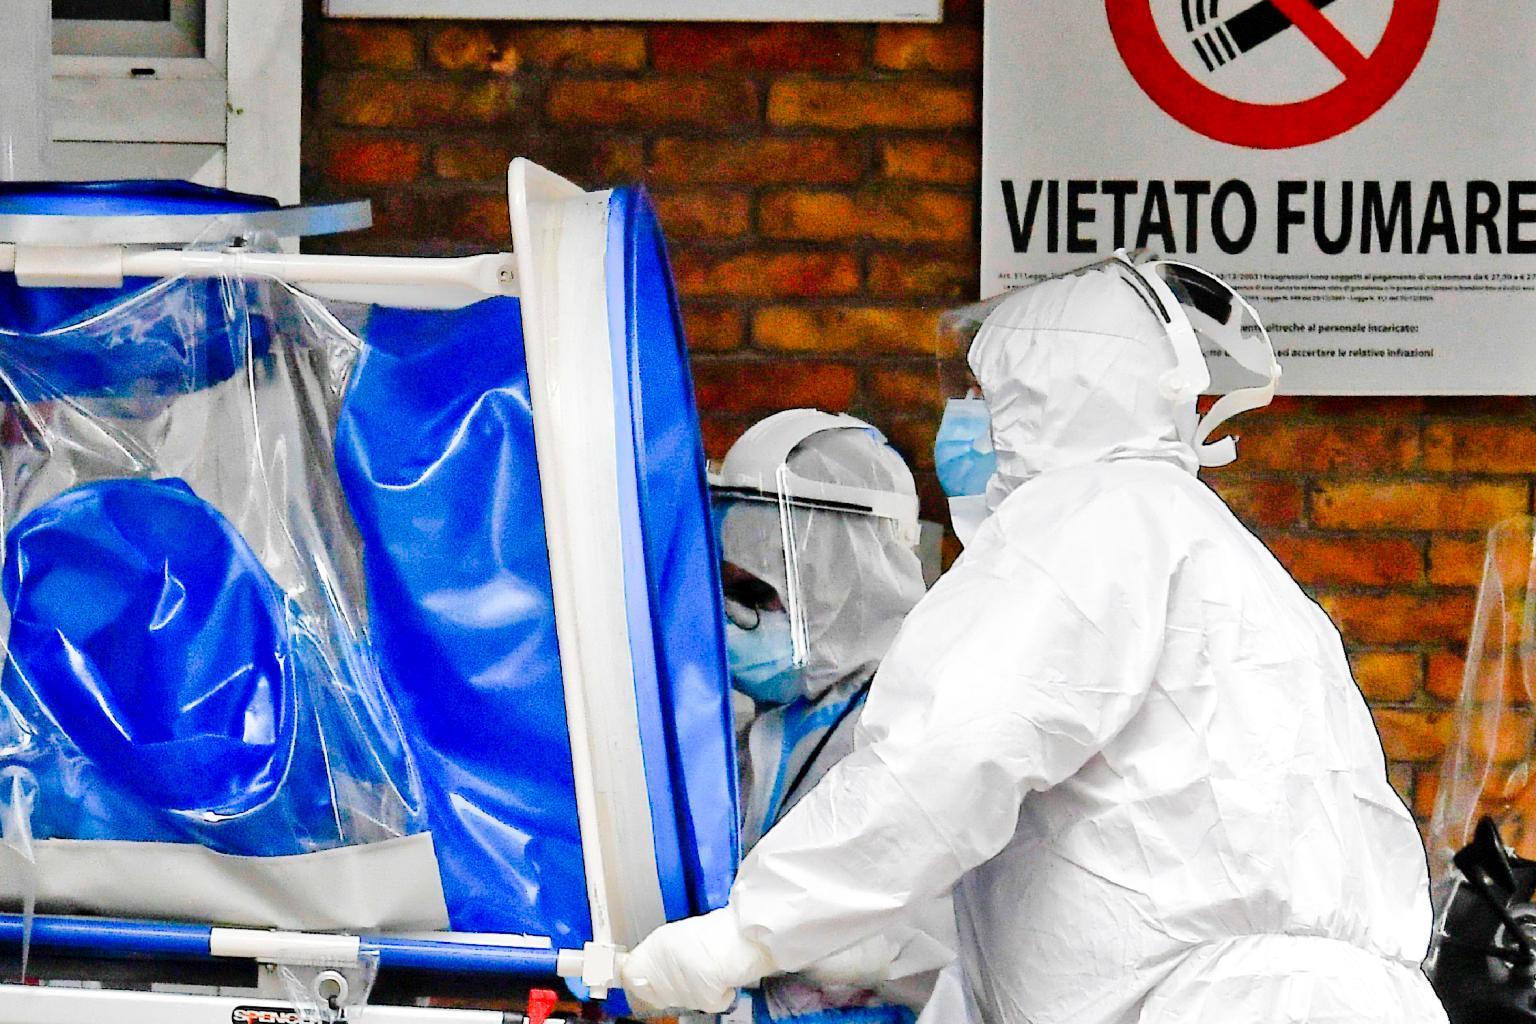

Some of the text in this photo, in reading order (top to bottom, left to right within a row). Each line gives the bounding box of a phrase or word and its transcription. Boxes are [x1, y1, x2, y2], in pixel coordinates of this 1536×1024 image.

[1001, 179, 1536, 255] VIETATO FUMARE
[1318, 322, 1366, 334] personale
[1348, 348, 1385, 358] relative
[1387, 348, 1434, 358] infrazioni
